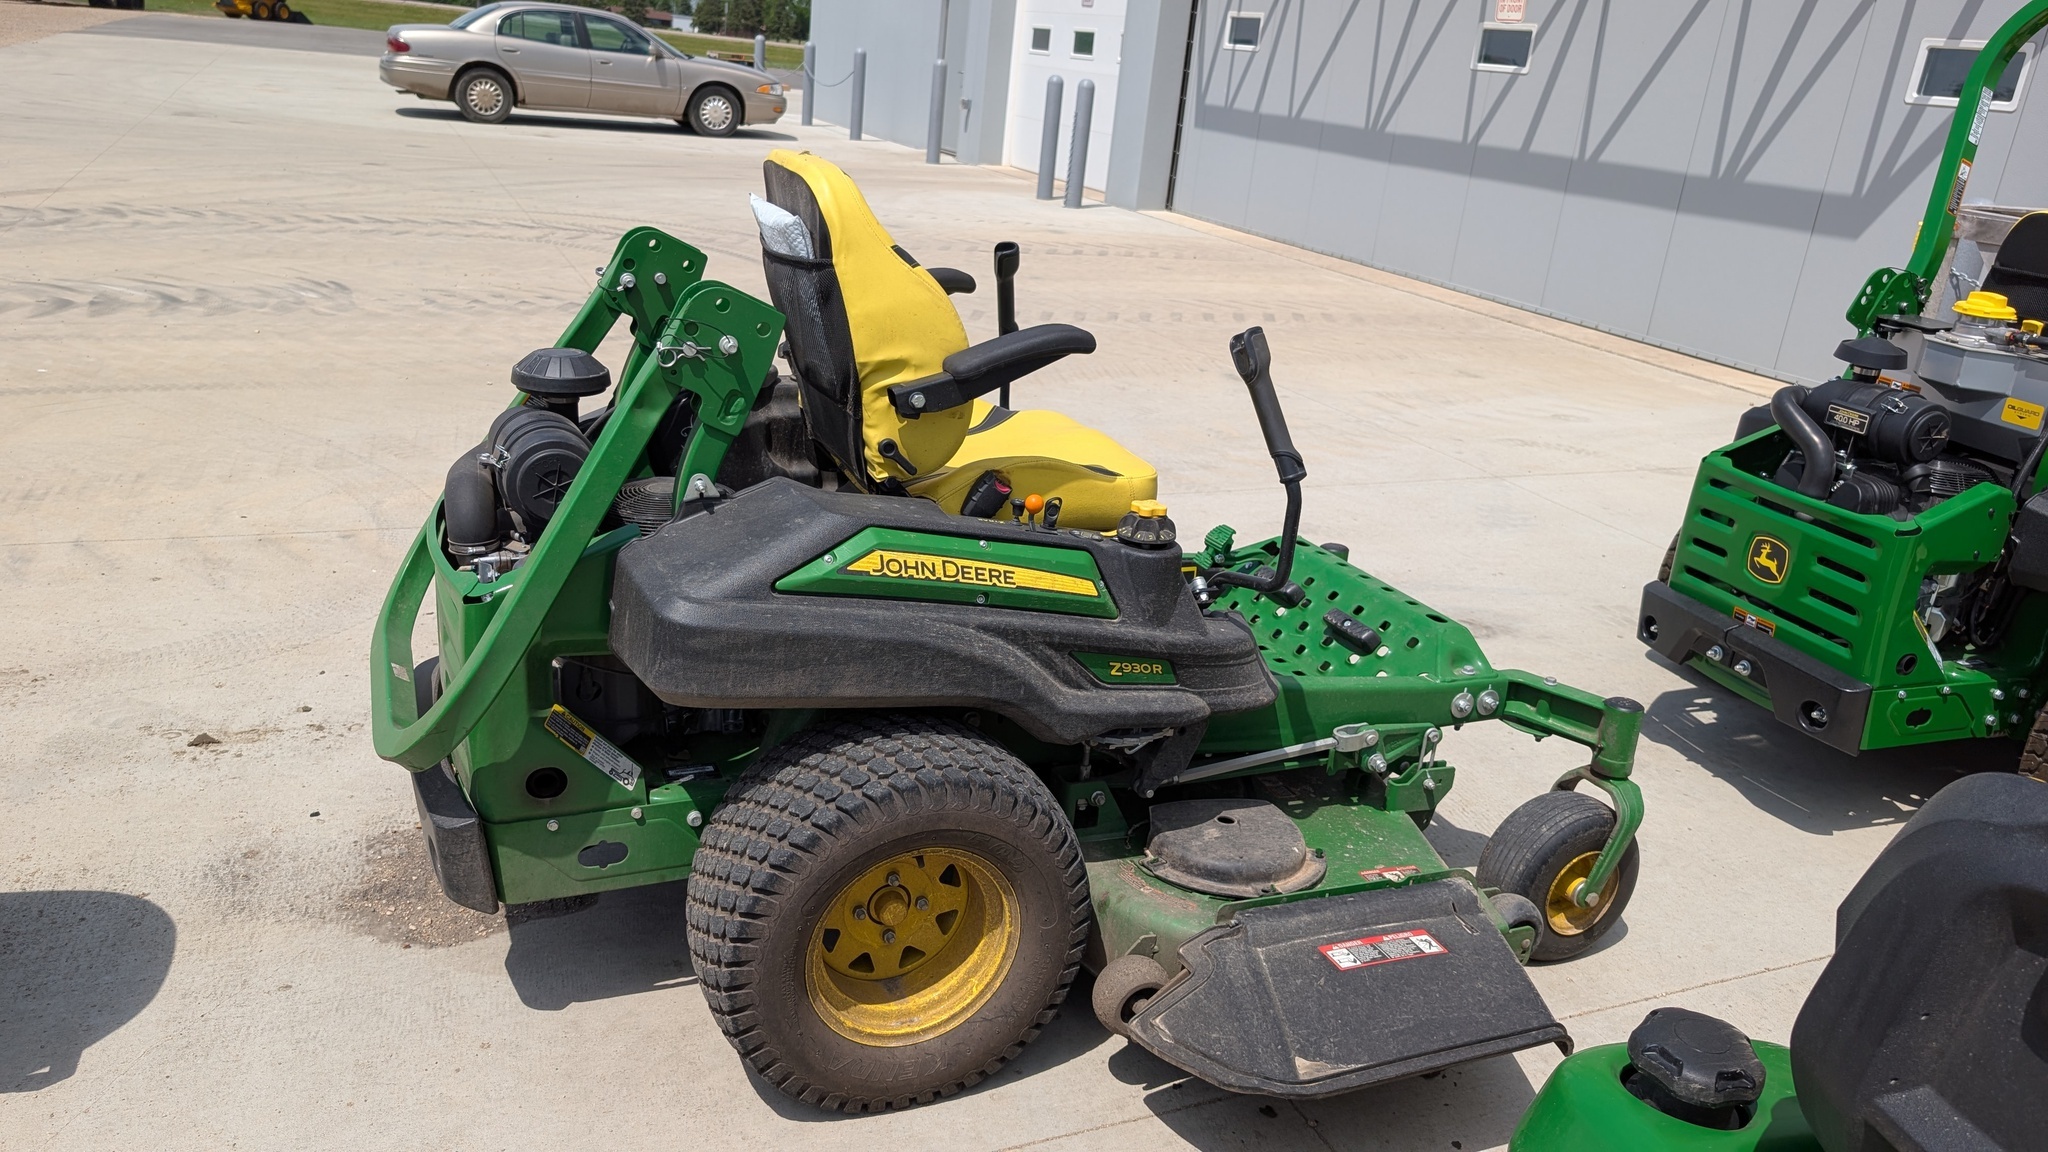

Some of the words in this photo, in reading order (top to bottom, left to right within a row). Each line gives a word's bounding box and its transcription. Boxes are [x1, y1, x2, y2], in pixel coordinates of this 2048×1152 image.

[1499, 4, 1506, 13] OF
[1507, 4, 1522, 13] DOOR
[2007, 404, 2040, 417] OILGUARD
[872, 554, 936, 577] JOHN
[942, 559, 1016, 586] DEERE
[565, 714, 586, 732] CAUTION
[1388, 932, 1414, 940] PELIGRO
[1338, 940, 1364, 949] DANGER
[829, 1050, 949, 1081] KENDA
